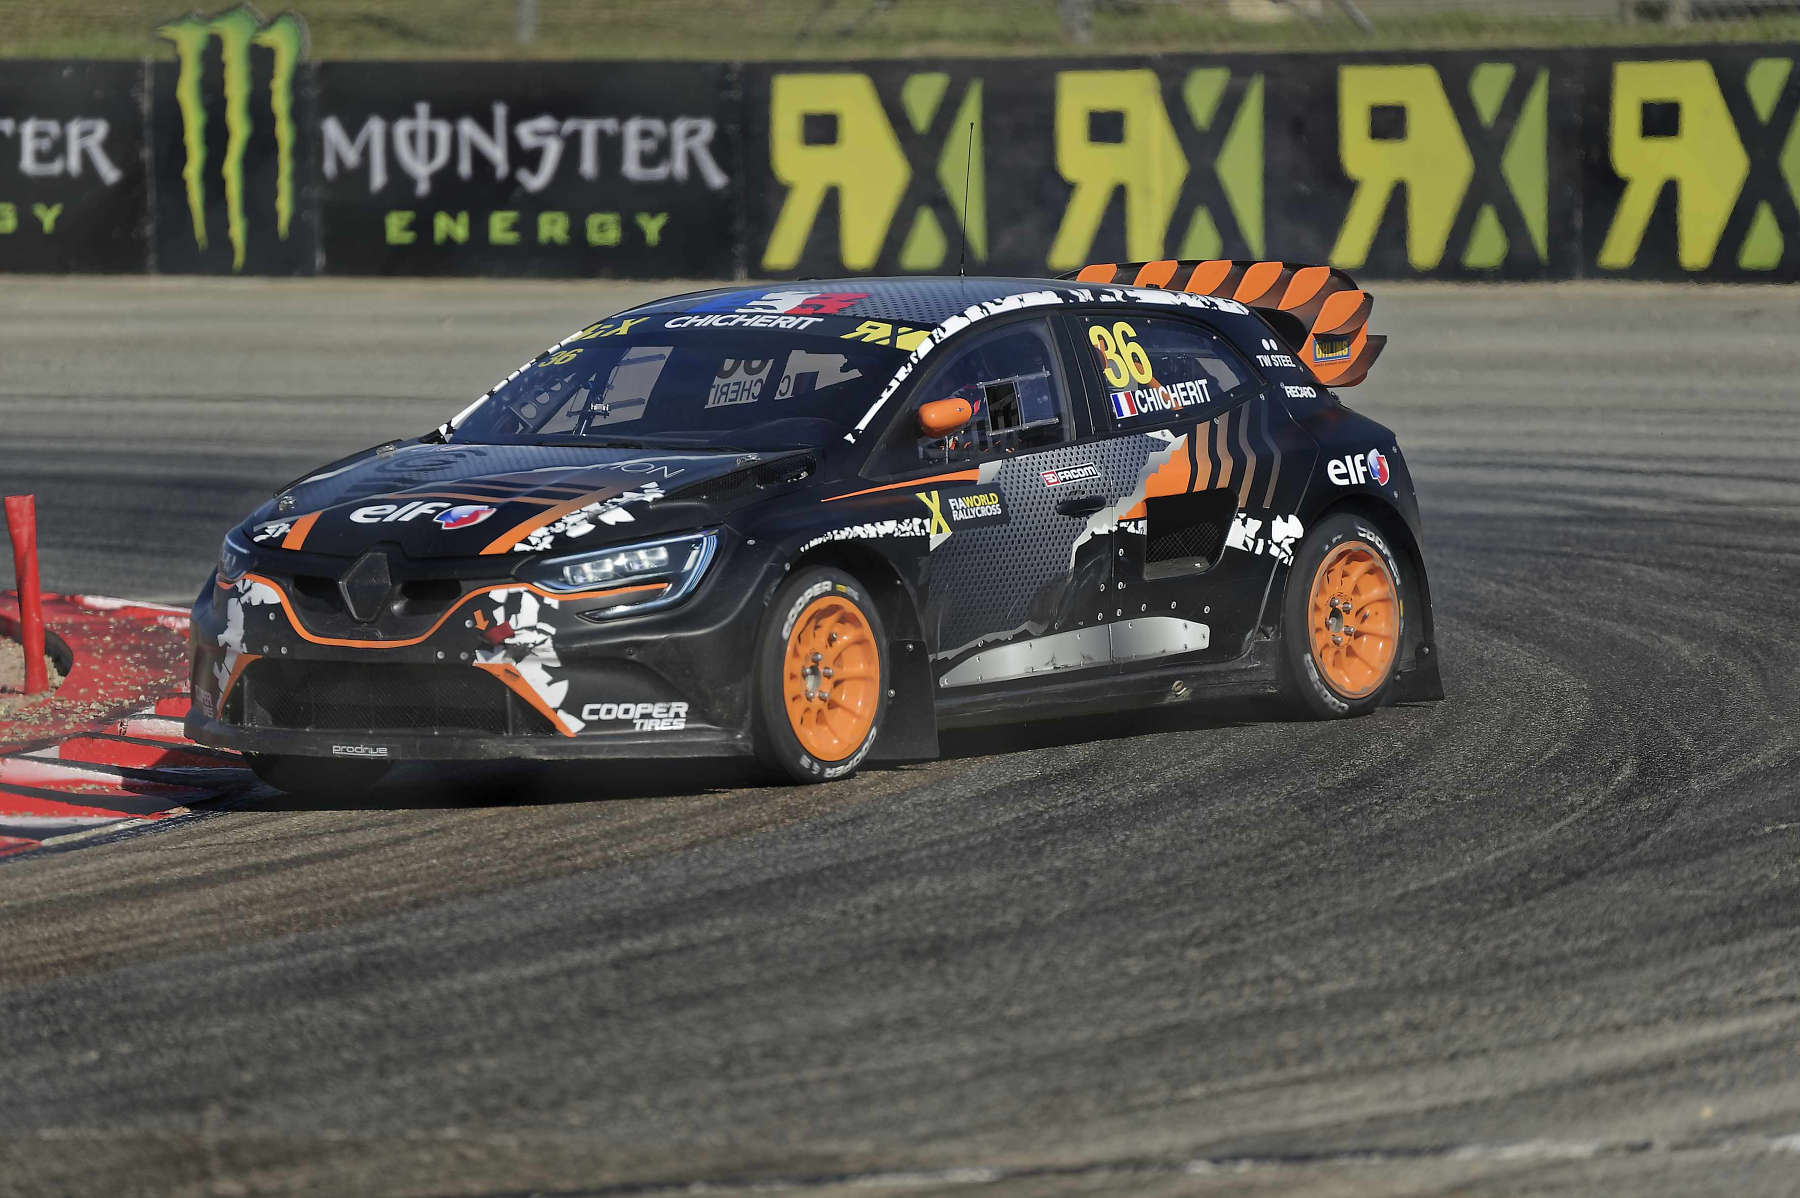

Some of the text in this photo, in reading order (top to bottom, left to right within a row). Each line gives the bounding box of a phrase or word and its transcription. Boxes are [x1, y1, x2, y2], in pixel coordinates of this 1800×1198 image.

[321, 101, 730, 197] MONSTER
[384, 210, 670, 247] ENERGY
[664, 314, 824, 331] CHICHERIT
[1089, 321, 1153, 388] 36
[1256, 355, 1296, 368] TW STEEL
[1135, 379, 1211, 413] CHICHERIT
[1285, 386, 1317, 398] RECARO
[1057, 465, 1098, 482] FACOM
[1327, 453, 1367, 486] elf
[349, 501, 449, 524] elf
[952, 504, 1002, 521] RALLYCROSS
[782, 580, 833, 640] COOPER
[581, 701, 689, 720] COOPER
[633, 718, 687, 731] TIRES
